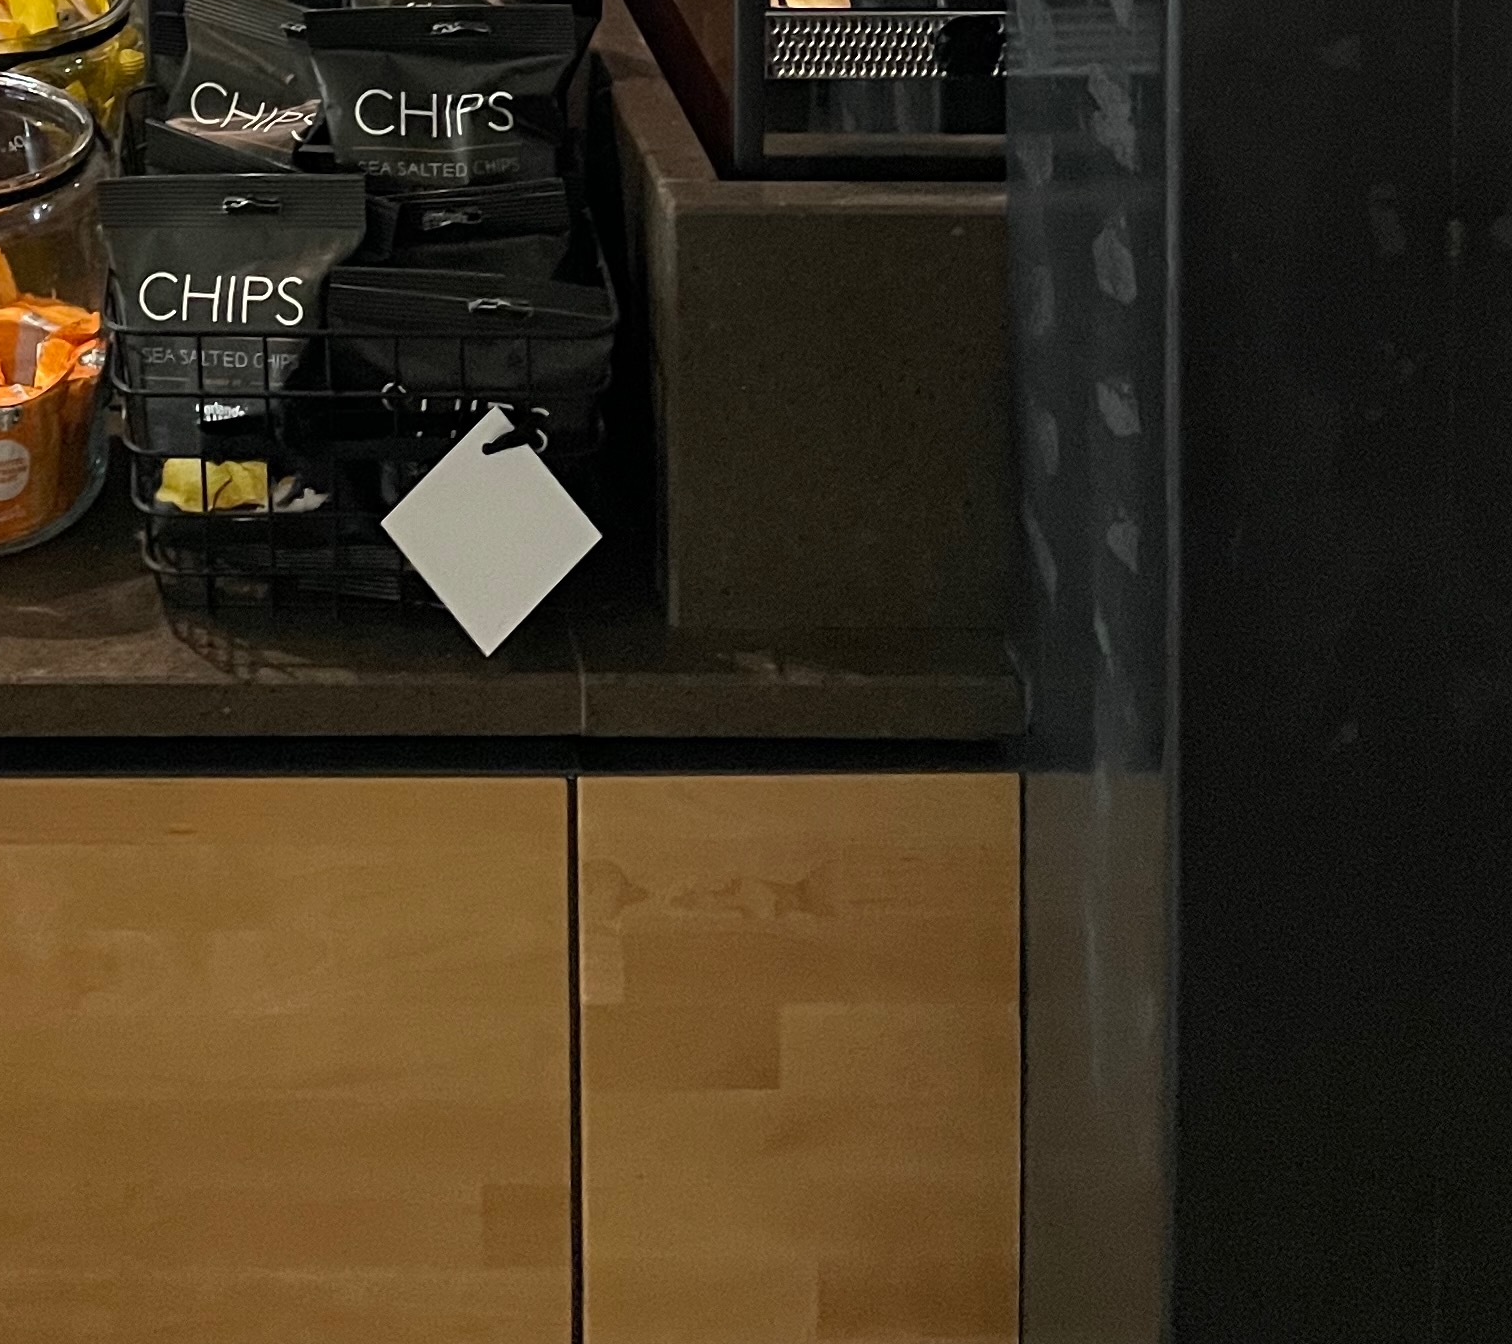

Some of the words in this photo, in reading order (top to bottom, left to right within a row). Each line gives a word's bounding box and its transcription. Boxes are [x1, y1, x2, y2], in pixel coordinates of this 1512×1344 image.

[354, 88, 514, 137] CHIPS
[359, 160, 391, 176] SEA
[397, 160, 467, 177] SALTED
[138, 272, 304, 326] CHIPS
[141, 349, 175, 365] SEA
[180, 350, 249, 368] SALTED
